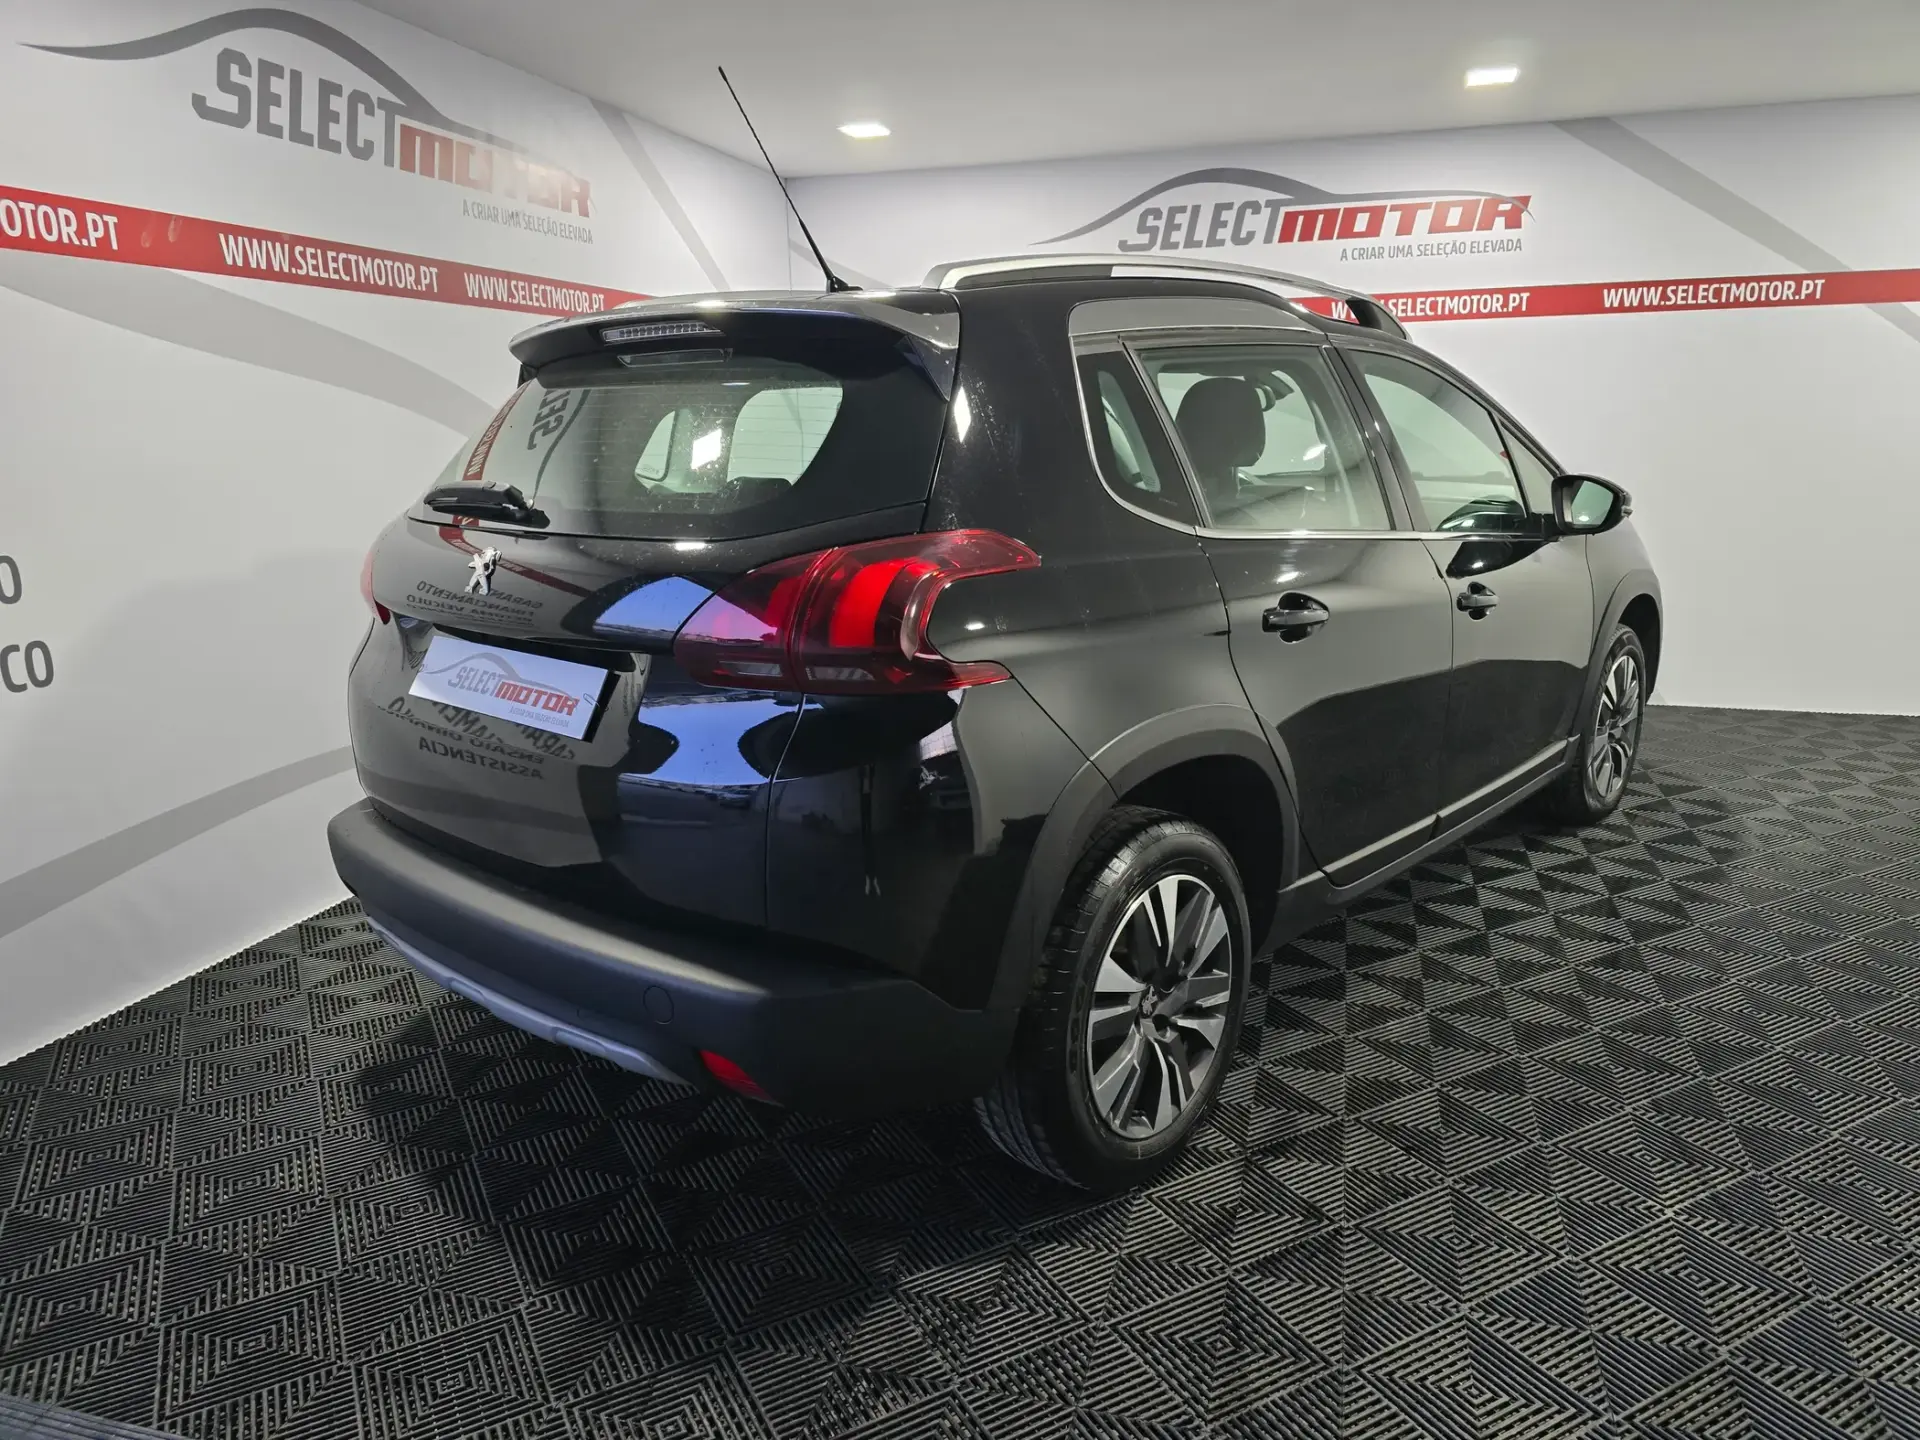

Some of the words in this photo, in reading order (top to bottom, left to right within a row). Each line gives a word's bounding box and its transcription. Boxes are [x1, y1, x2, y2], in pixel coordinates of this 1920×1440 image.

[0, 199, 118, 250] OTOR.PT
[463, 199, 470, 217] A
[471, 201, 500, 226] CRIAR
[501, 210, 521, 229] UMA
[523, 212, 558, 237] SELEÇÃO
[559, 223, 594, 245] ELEVADA
[219, 233, 438, 292] WWW.SELECTMOTOR.PT
[1340, 248, 1348, 262] A
[1351, 246, 1384, 260] CRIAR
[1388, 244, 1413, 258] UMA
[1416, 240, 1466, 258] SELEÇÃO
[1469, 238, 1522, 255] ELEVADA
[464, 272, 604, 313] WWW.SELECTMOTOR.PT
[1331, 292, 1530, 319] WSELECTMOTOR.PT
[1603, 279, 1825, 307] WWW.SELECTMOTOR.PT
